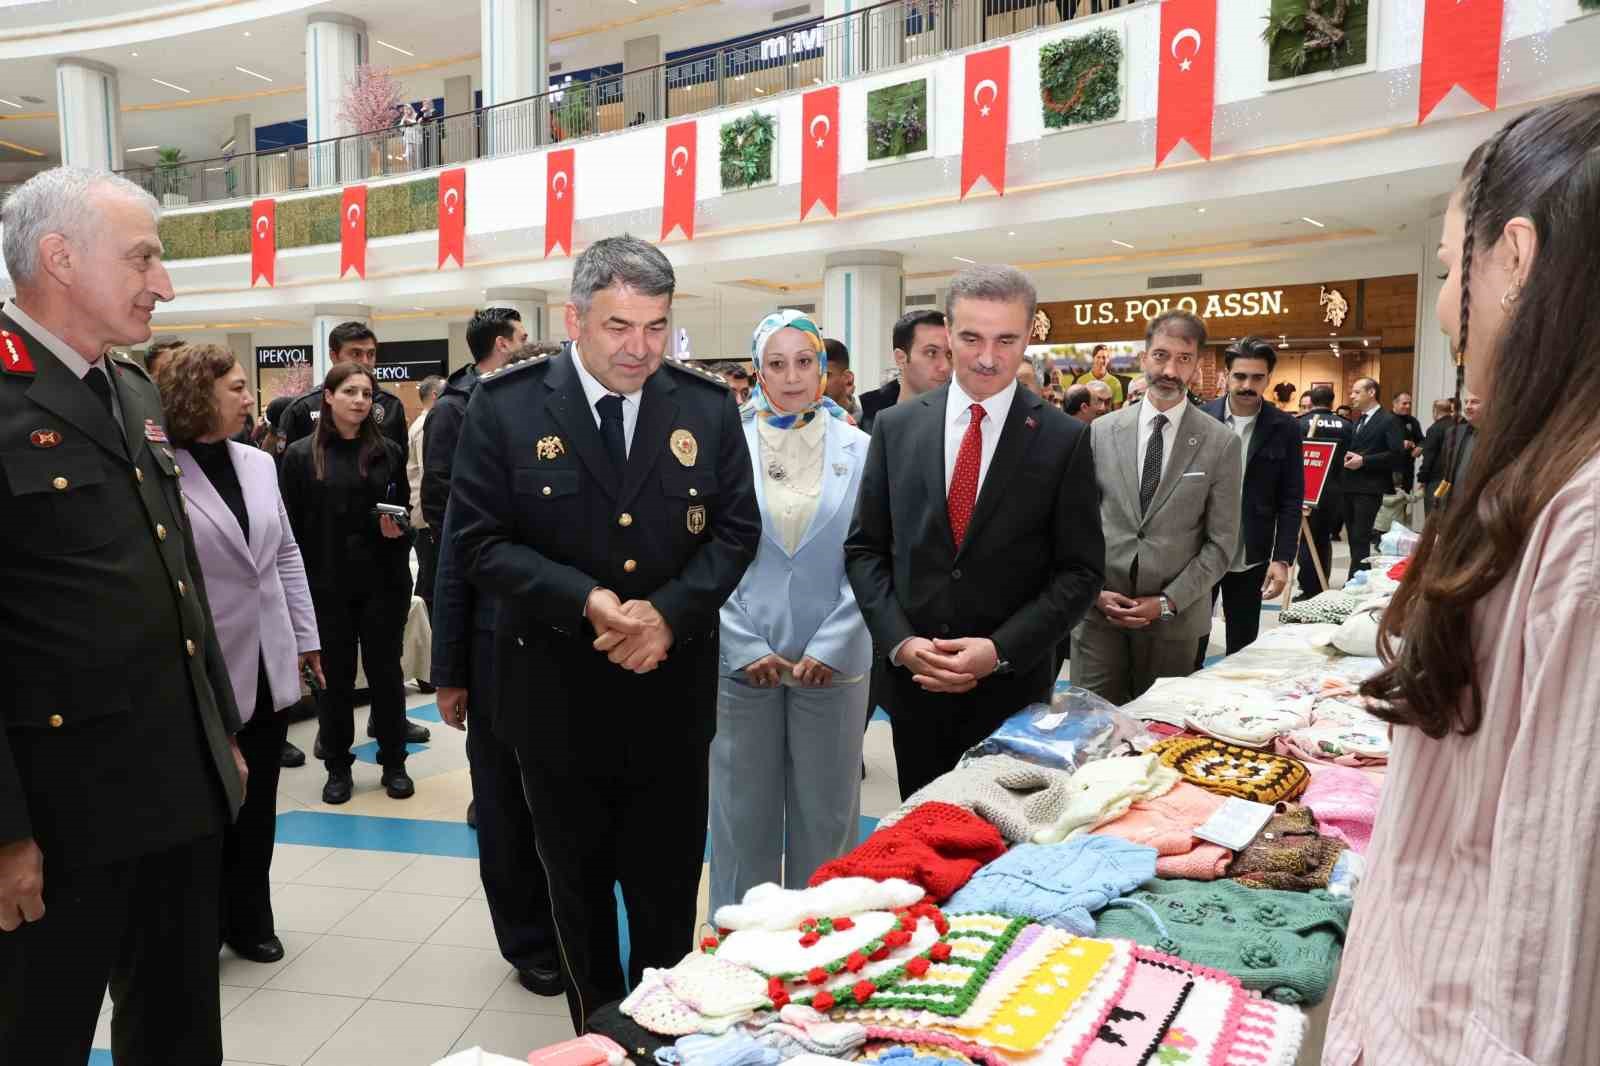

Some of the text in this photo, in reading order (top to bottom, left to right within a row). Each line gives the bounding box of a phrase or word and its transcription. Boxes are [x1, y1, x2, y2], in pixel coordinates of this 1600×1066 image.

[761, 23, 825, 60] mavi
[1074, 302, 1119, 325] U.S.
[1203, 290, 1289, 318] ASSN.
[259, 349, 308, 363] IPEKYOL
[372, 366, 410, 380] PEKYOL
